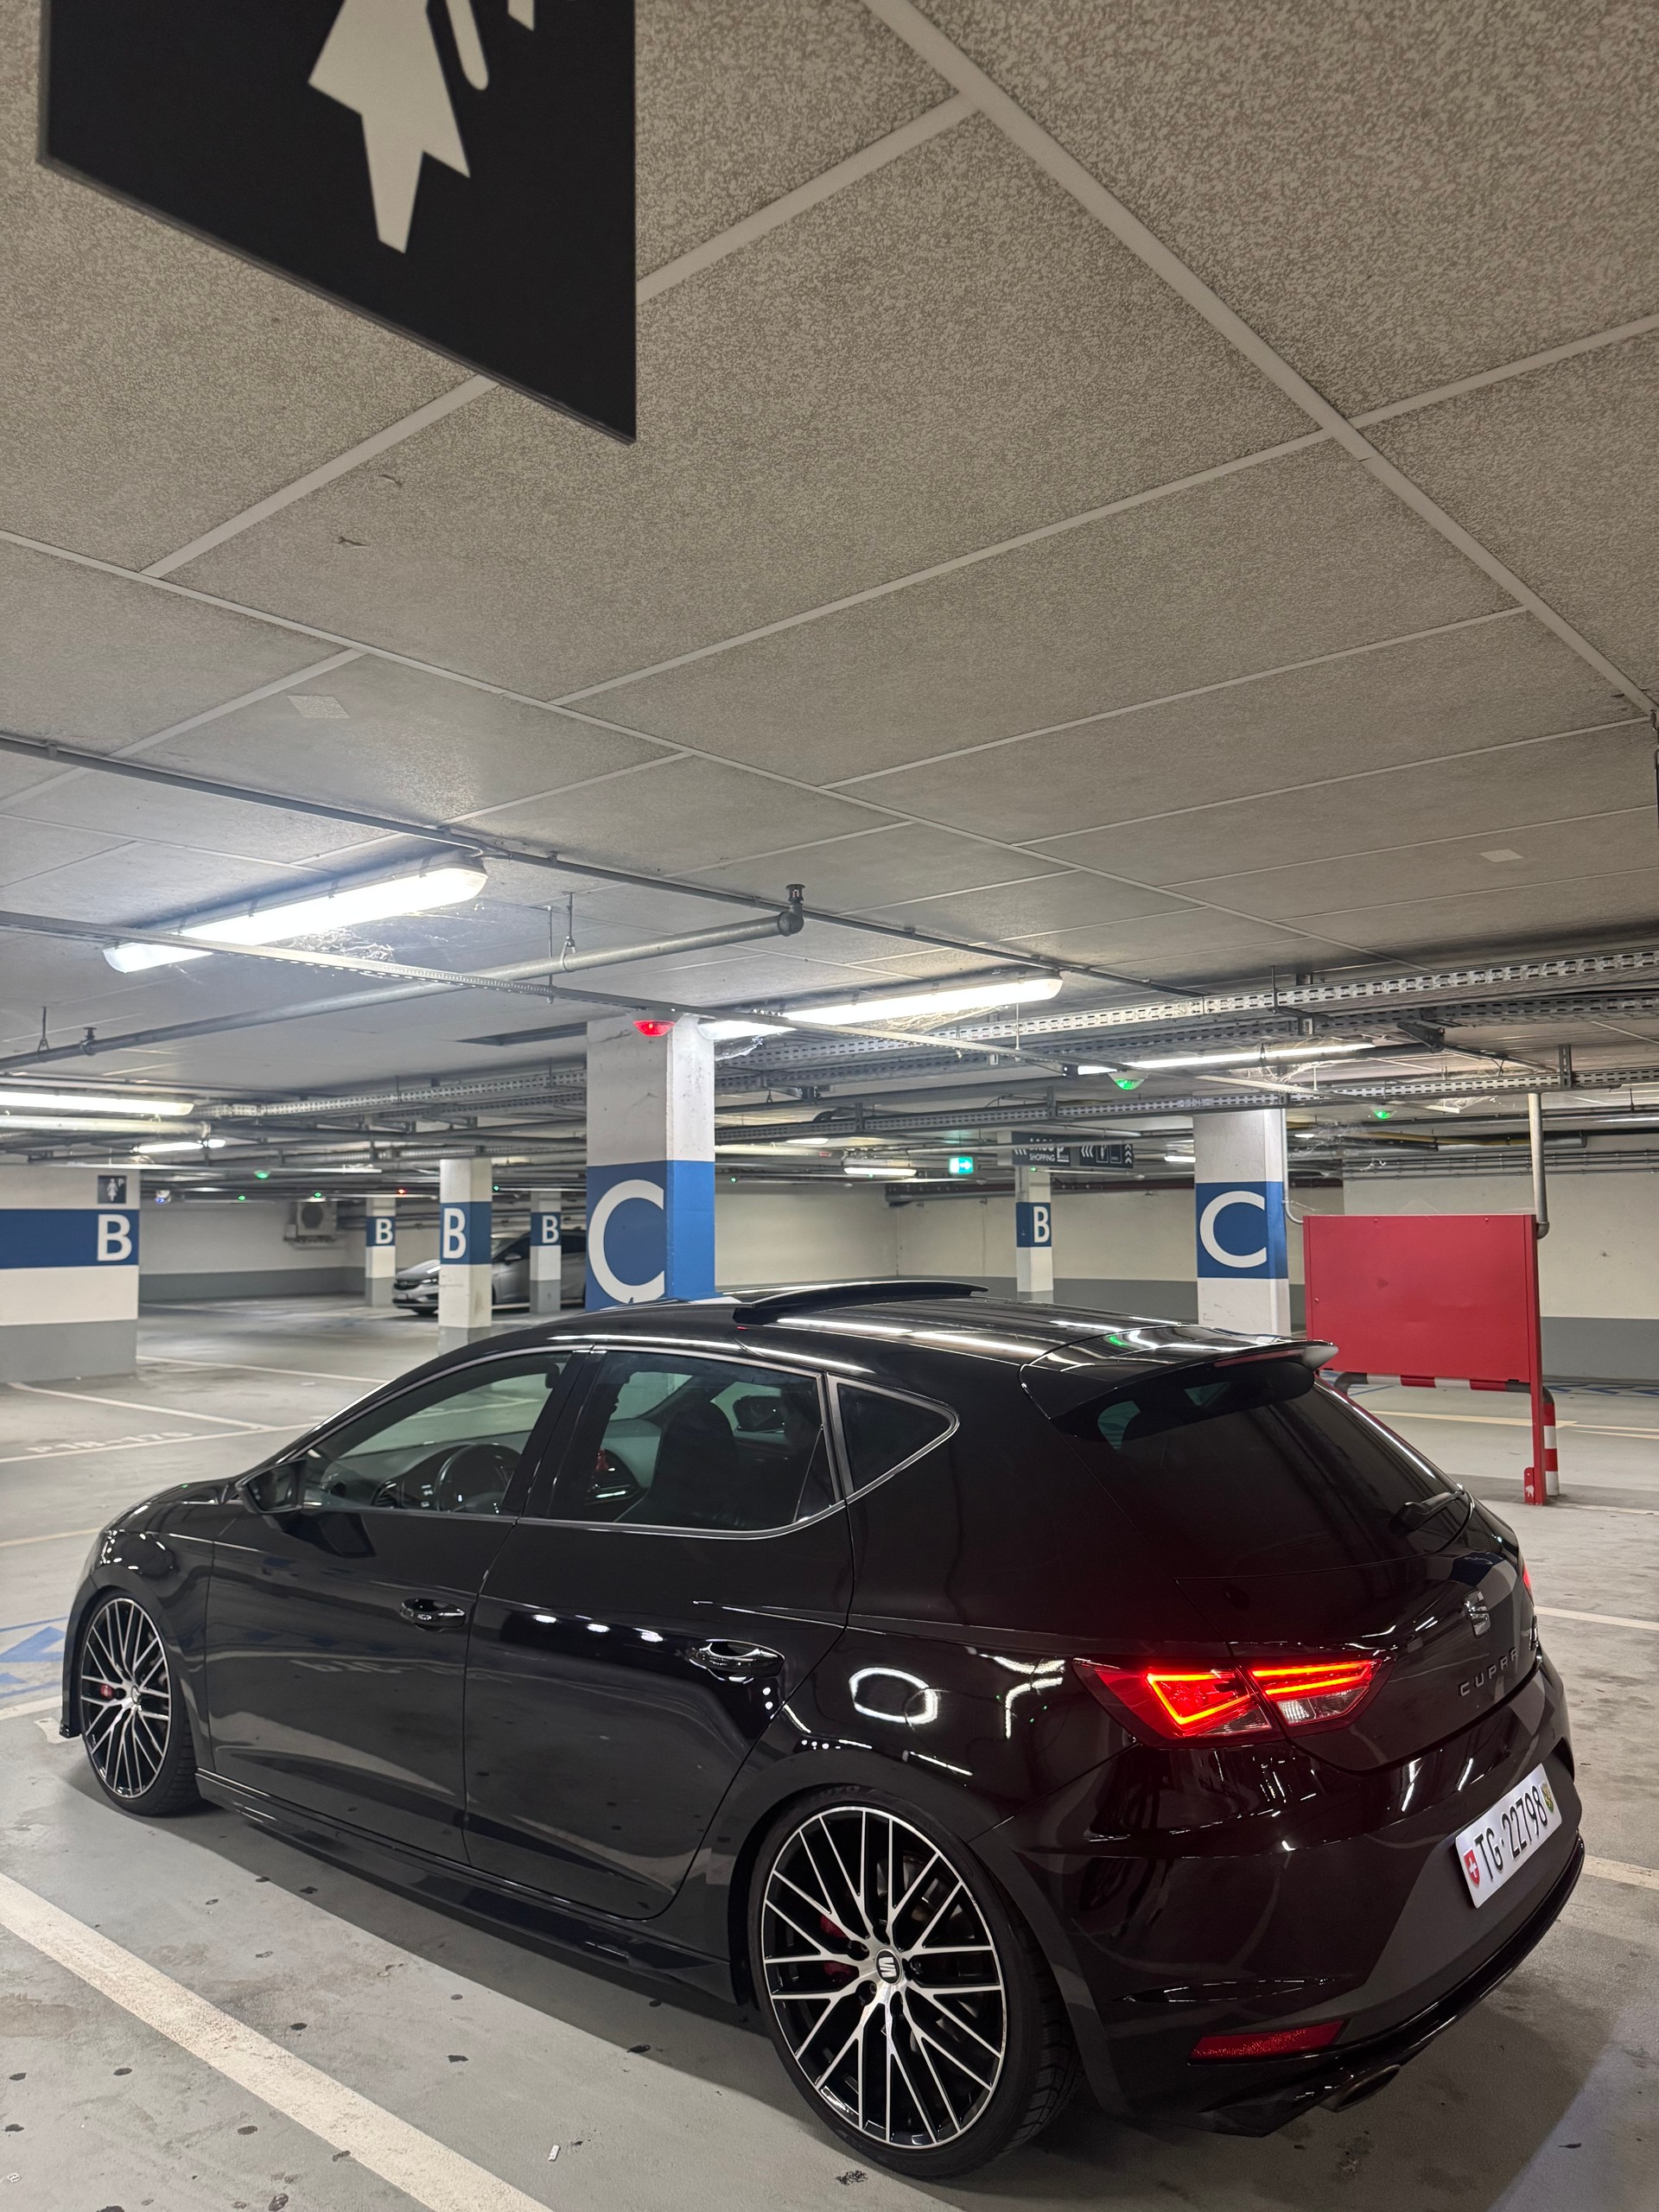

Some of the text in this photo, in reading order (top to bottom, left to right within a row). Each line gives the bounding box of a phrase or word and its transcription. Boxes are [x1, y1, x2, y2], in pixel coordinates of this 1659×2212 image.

[98, 1213, 132, 1262] B
[375, 1217, 394, 1245] B
[442, 1207, 467, 1260] B
[542, 1215, 559, 1244] B
[588, 1179, 665, 1305] C
[1033, 1205, 1051, 1243] B
[1199, 1190, 1268, 1268] C
[1459, 1646, 1518, 1697] CUPRA
